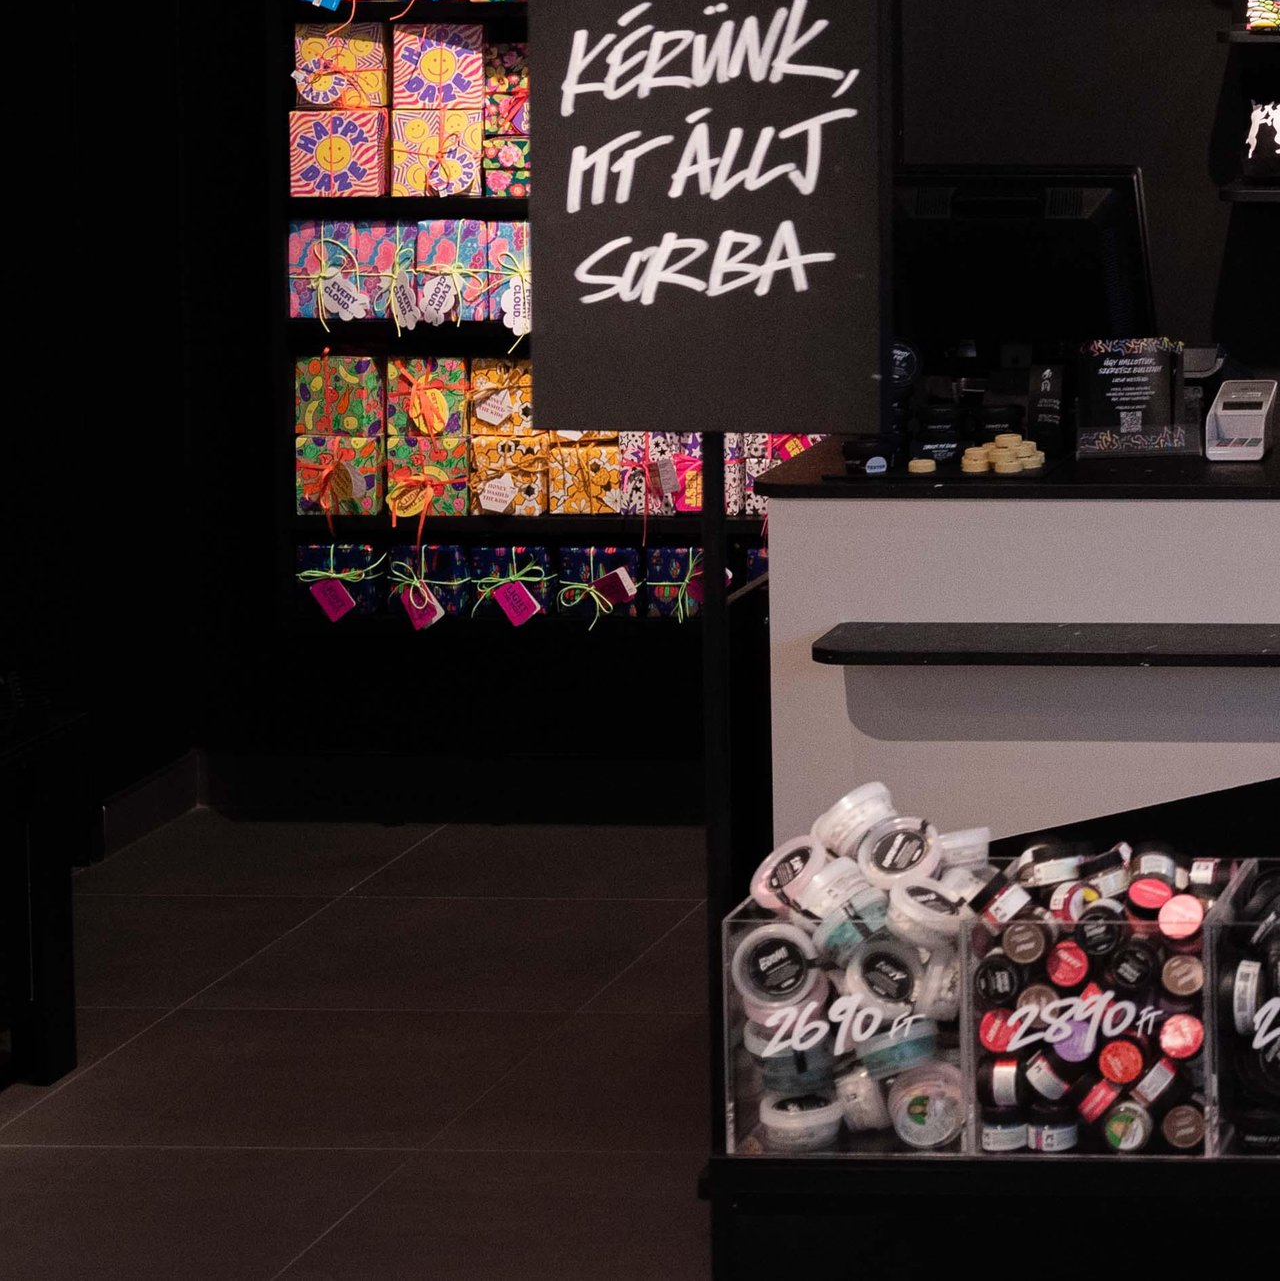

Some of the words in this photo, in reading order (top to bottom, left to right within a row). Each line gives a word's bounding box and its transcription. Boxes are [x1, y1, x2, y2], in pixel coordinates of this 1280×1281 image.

[400, 28, 475, 67] HAPPY
[403, 72, 473, 104] DAZE
[297, 116, 370, 155] HAPPY
[300, 160, 368, 193] DAZE
[446, 148, 475, 189] HAPPY
[566, 130, 675, 214] ITT
[667, 107, 859, 201] ÁLLJ
[574, 219, 837, 306] SORBA
[330, 281, 358, 305] EVERY
[398, 284, 414, 314] EVERY
[433, 283, 452, 315] EVERY
[489, 396, 503, 406] ONEY
[684, 471, 697, 508] BEST
[762, 994, 883, 1057] 2690
[1006, 990, 1139, 1052] 2890
